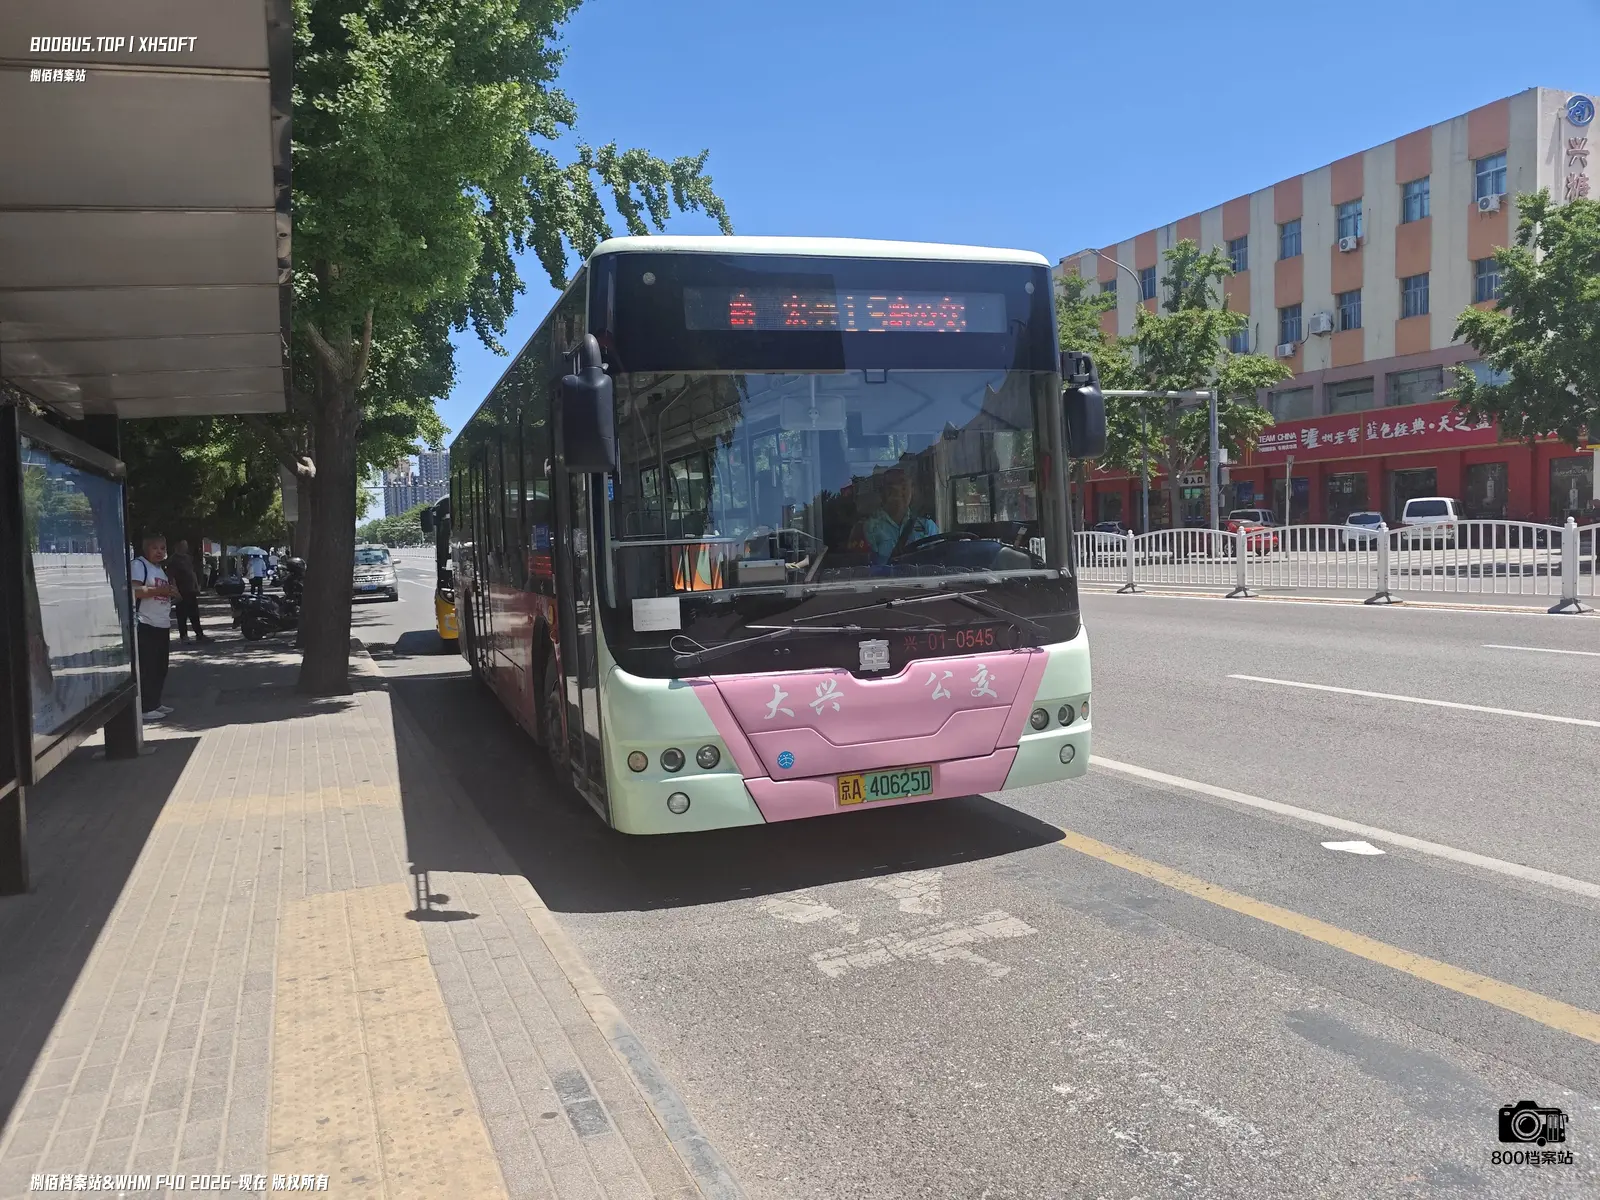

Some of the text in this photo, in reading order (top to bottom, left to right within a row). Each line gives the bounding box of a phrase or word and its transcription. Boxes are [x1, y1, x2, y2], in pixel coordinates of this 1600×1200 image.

[1258, 431, 1297, 443] TEAM CHINA
[763, 663, 998, 720] 大兴 公交
